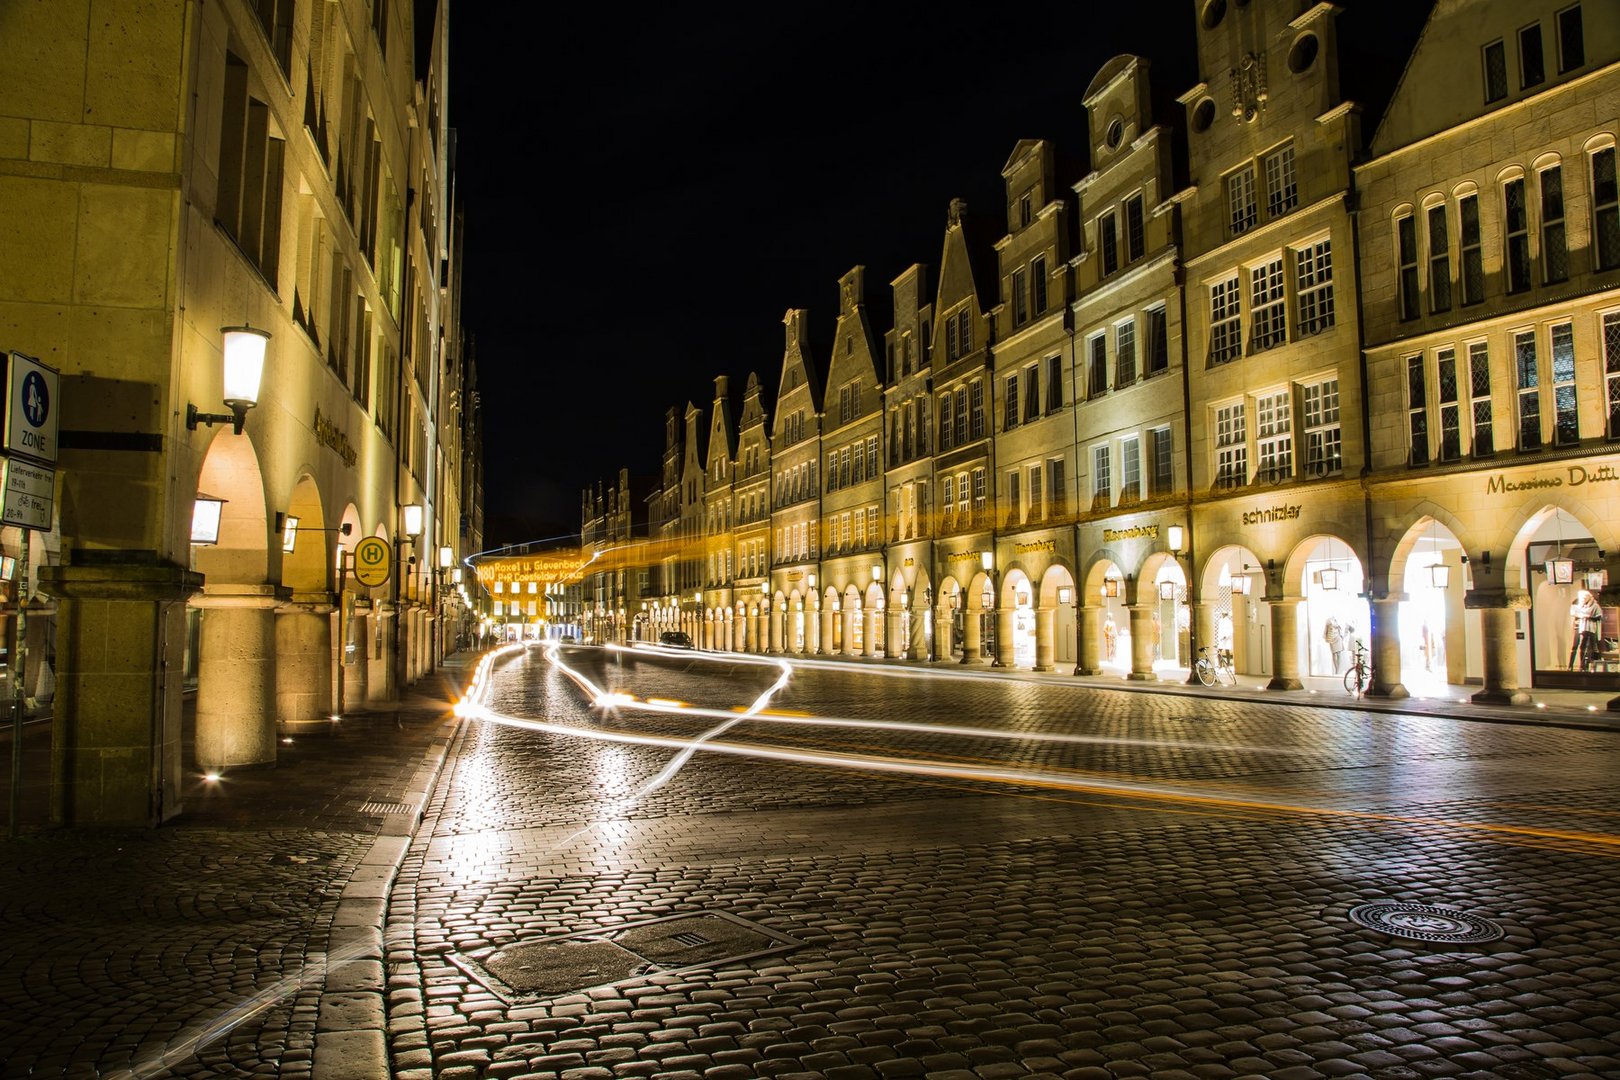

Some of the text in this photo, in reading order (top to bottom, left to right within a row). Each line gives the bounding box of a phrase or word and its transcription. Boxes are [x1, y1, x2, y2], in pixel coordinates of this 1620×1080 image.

[22, 430, 46, 451] ZONE
[1486, 465, 1619, 495] Massimo Dutti
[1242, 503, 1302, 525] schnitzler
[366, 547, 379, 561] H
[494, 562, 521, 572] Roxel
[514, 572, 557, 582] Coesfelder
